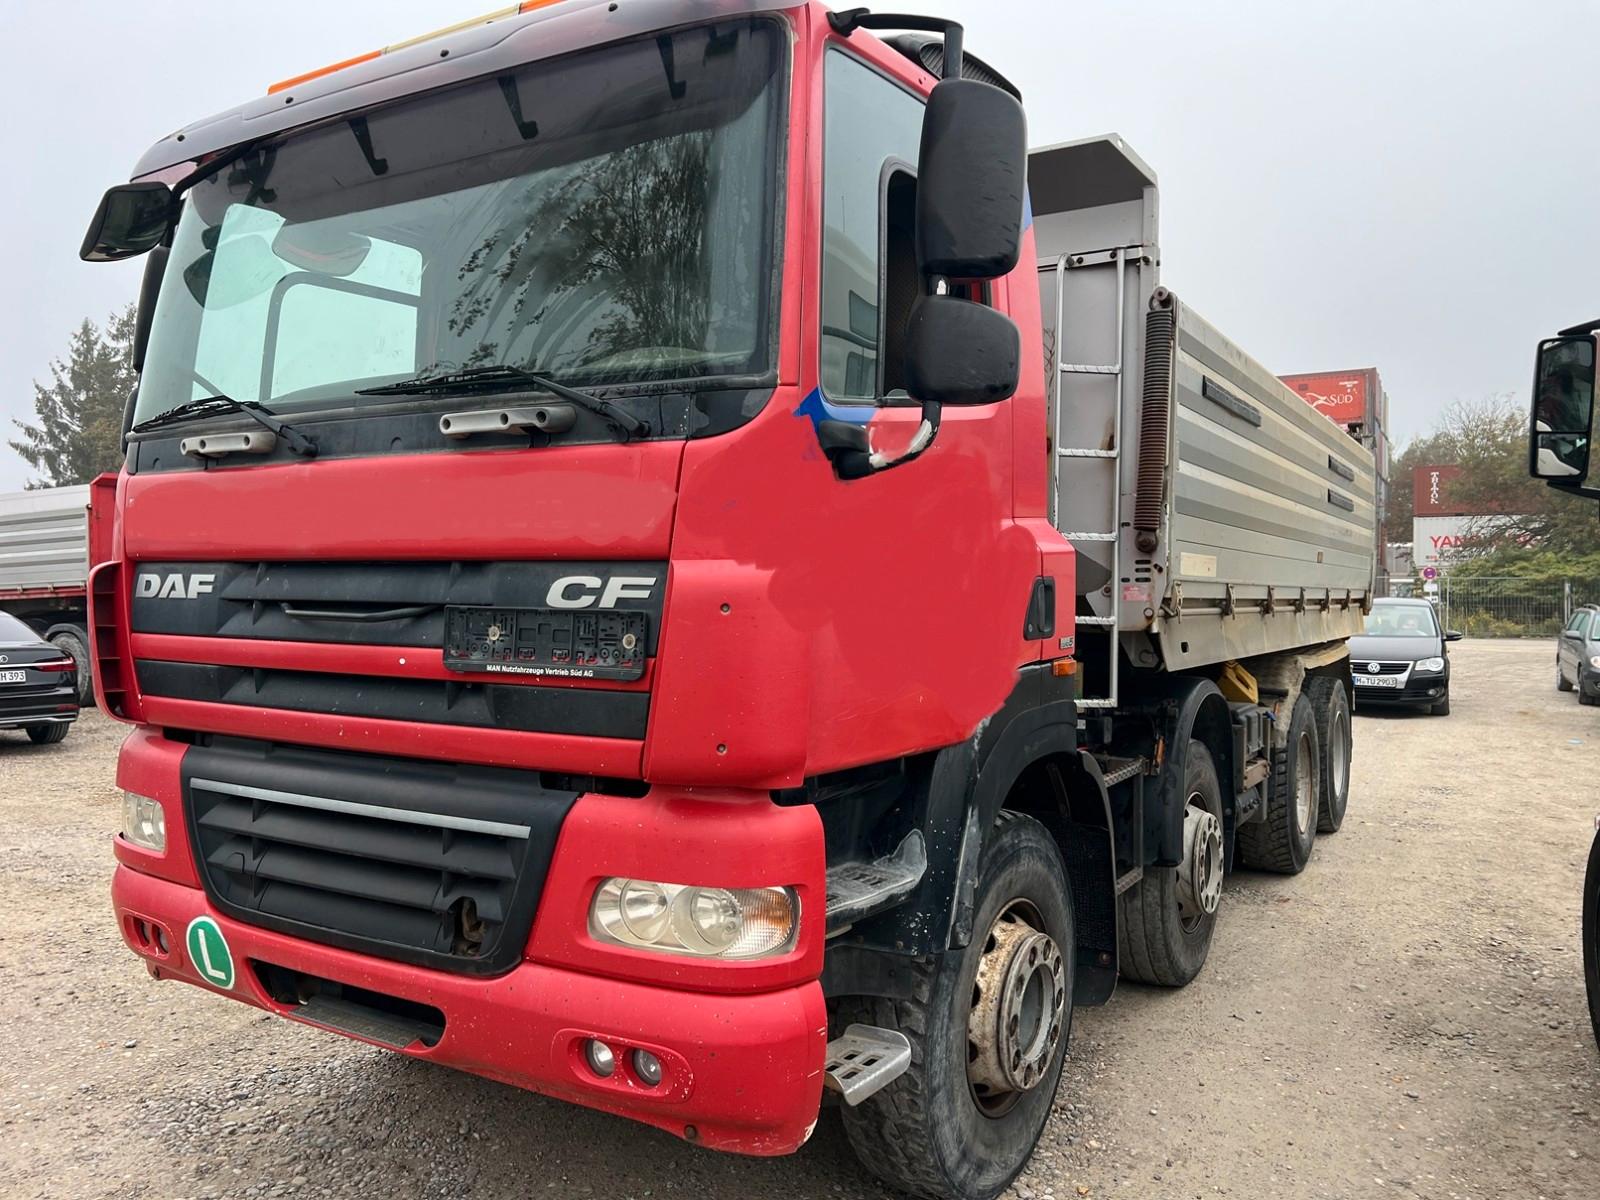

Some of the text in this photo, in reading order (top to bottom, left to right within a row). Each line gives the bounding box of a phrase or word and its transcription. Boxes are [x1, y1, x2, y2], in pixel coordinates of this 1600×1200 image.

[135, 573, 216, 598] DAF
[546, 576, 657, 608] CF
[8, 671, 25, 681] 393
[502, 666, 545, 675] Nutzfahrzeuge
[545, 668, 569, 676] Vertrieb
[570, 669, 583, 677] Süd
[198, 928, 227, 980] L
